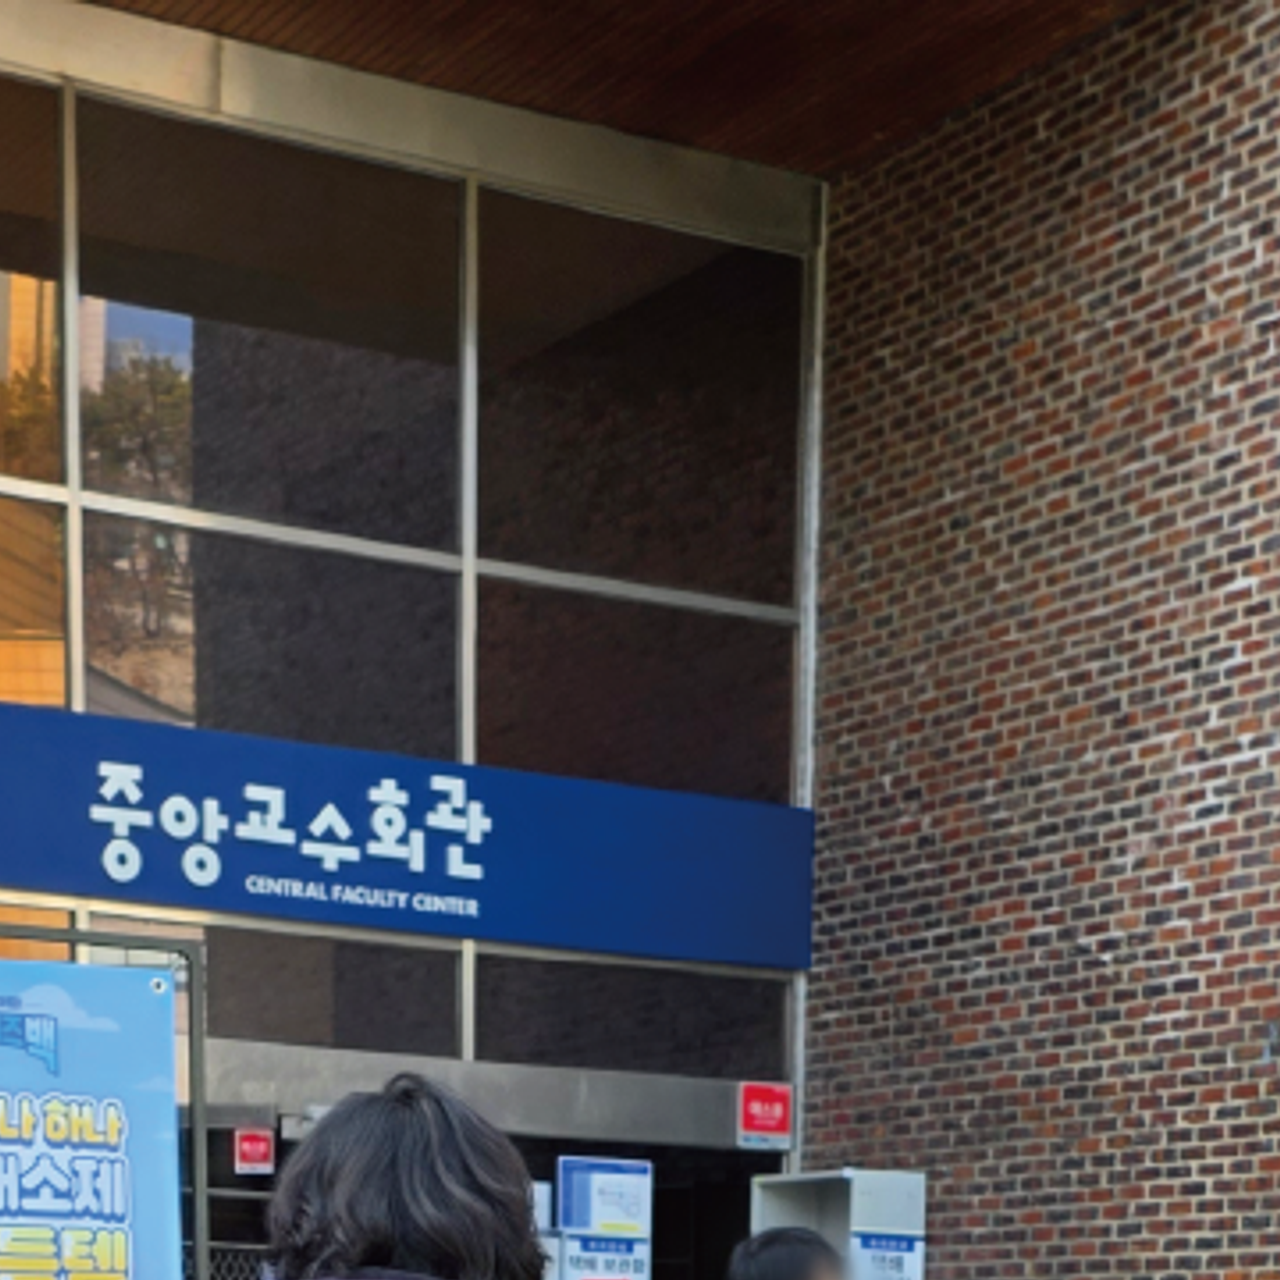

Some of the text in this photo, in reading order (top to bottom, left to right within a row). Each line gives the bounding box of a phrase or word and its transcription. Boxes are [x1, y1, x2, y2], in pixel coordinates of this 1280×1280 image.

[89, 761, 492, 887] 중앙교수회관
[245, 875, 479, 917] CENTRAL FACULTY CENTER
[43, 1096, 122, 1151] 하나
